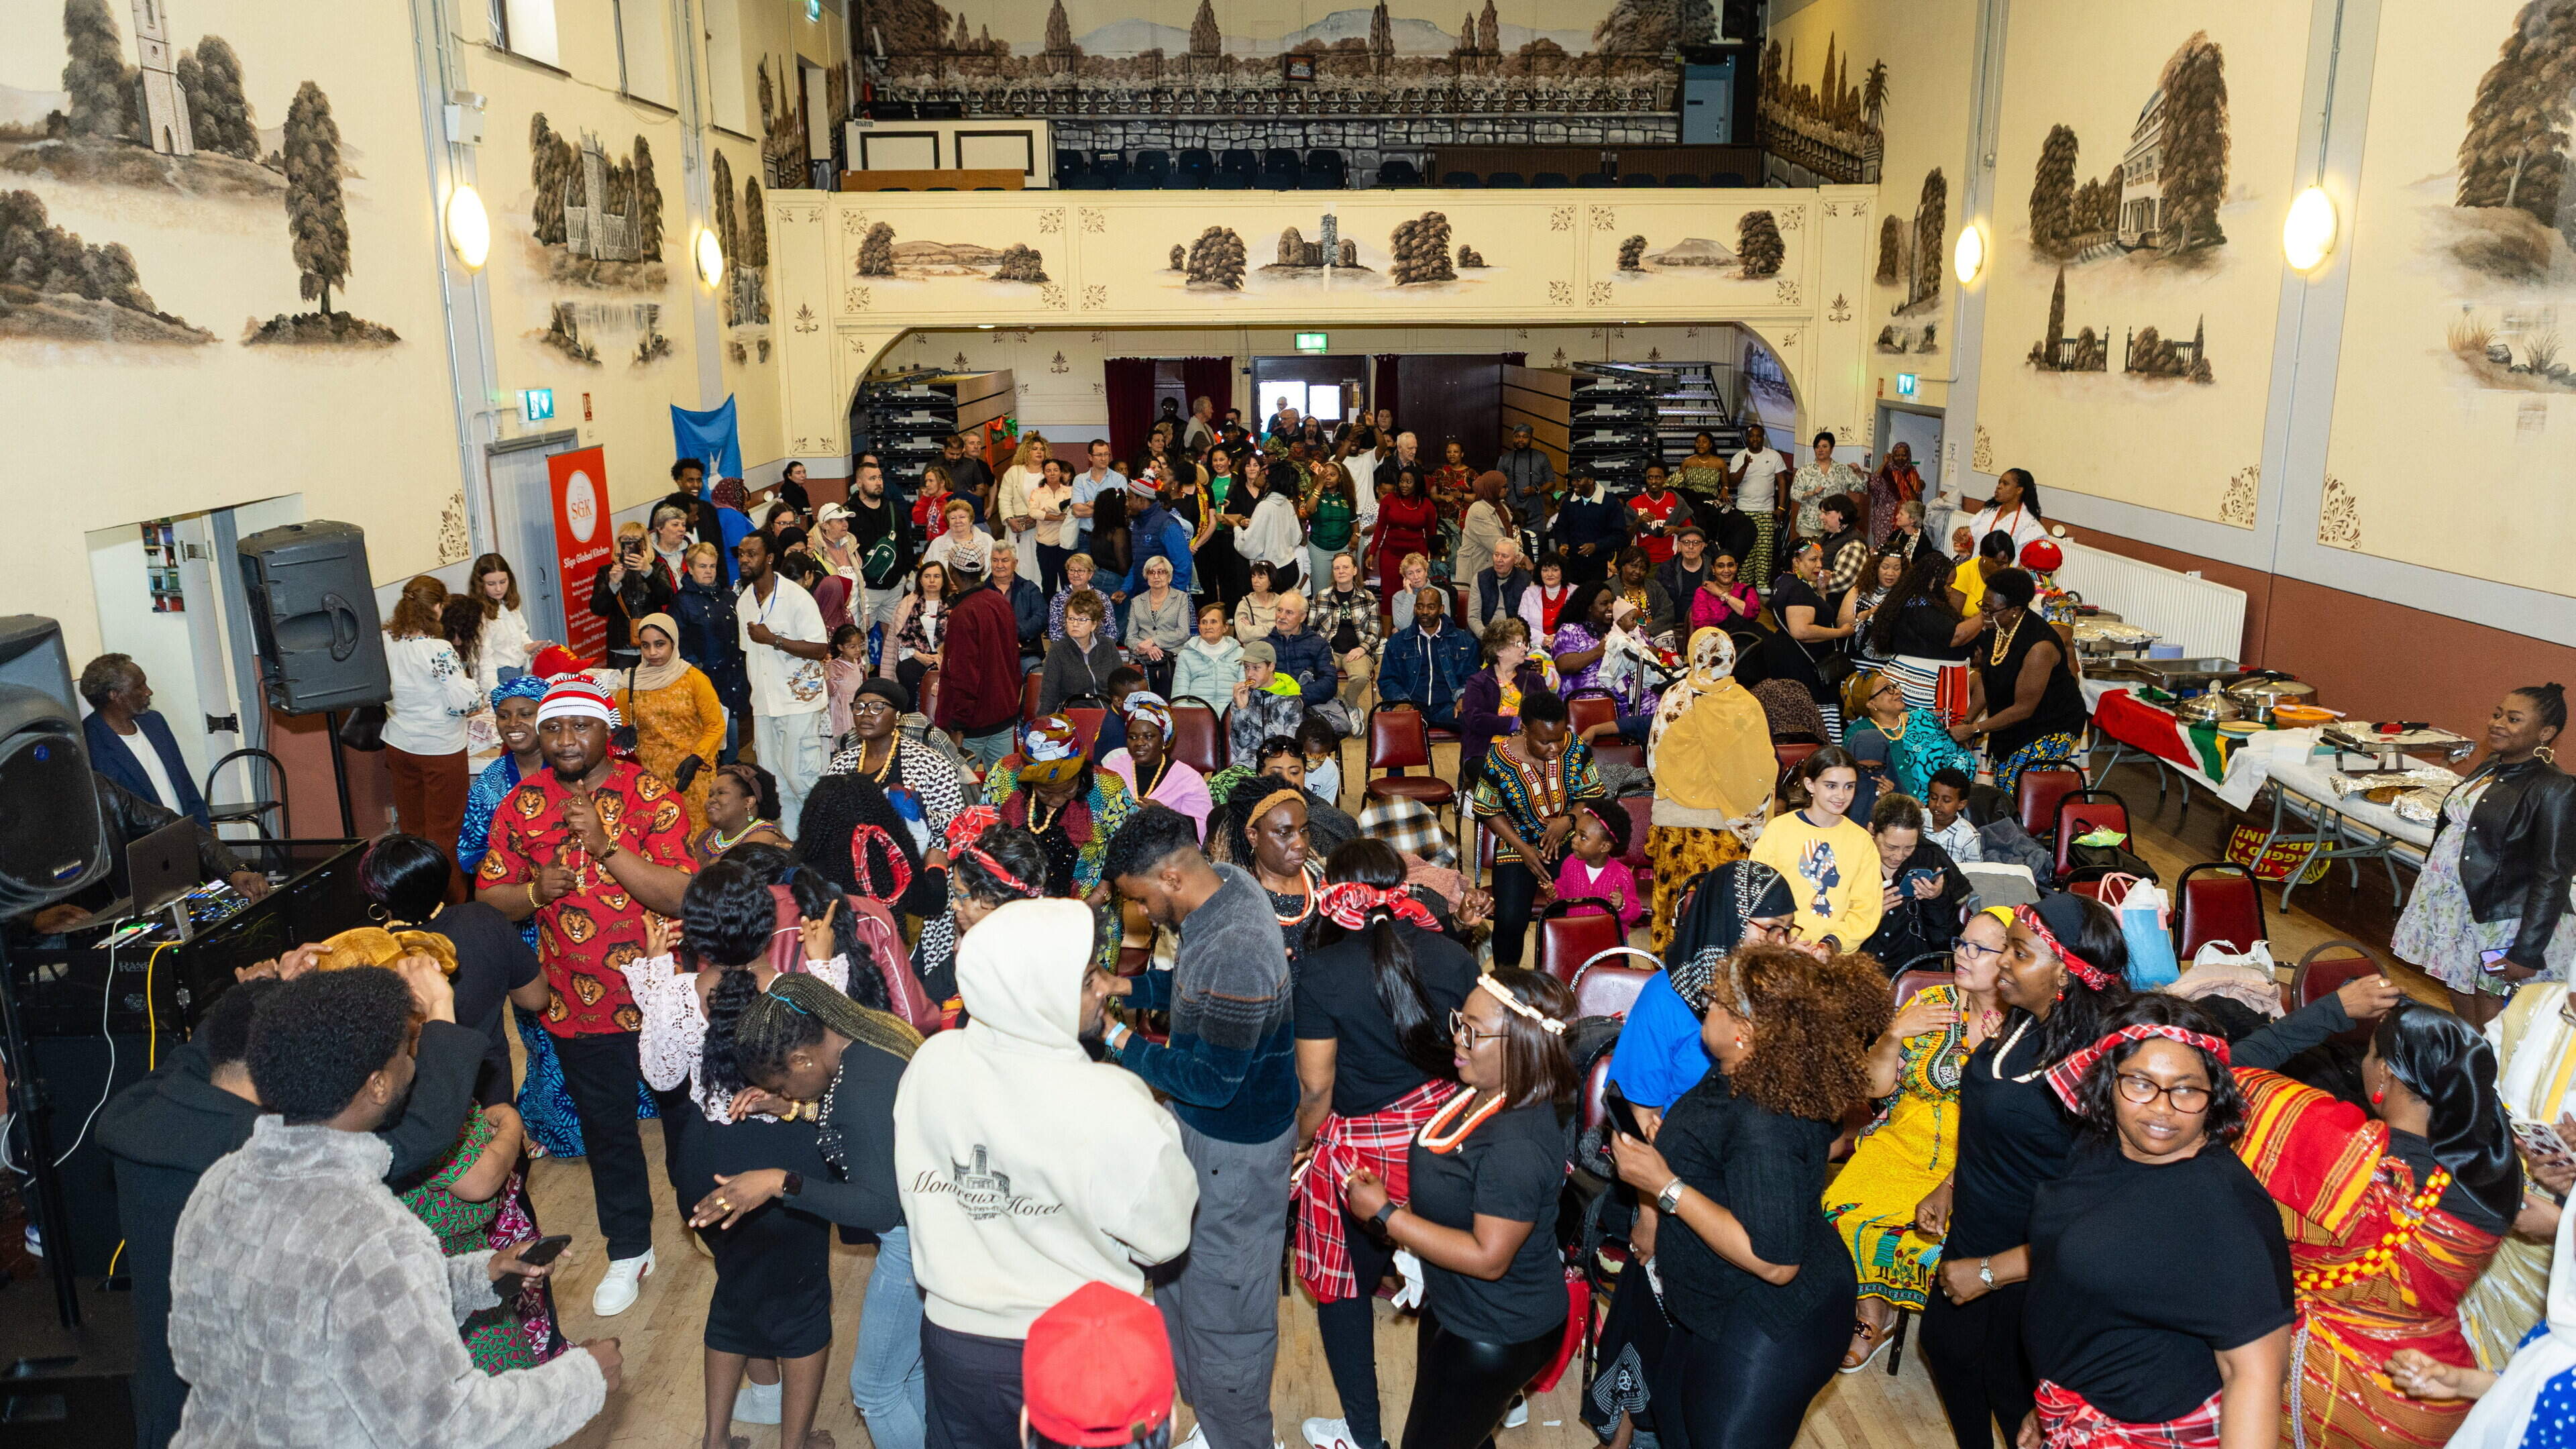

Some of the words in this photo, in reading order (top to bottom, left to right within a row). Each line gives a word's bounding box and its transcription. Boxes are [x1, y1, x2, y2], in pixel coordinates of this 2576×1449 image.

[572, 499, 592, 519] SGK
[564, 557, 576, 569] Sligo
[576, 550, 592, 564] Global
[593, 546, 610, 557] Kitchen
[904, 1170, 1000, 1203] Montreux
[1003, 1195, 1063, 1216] Hotel
